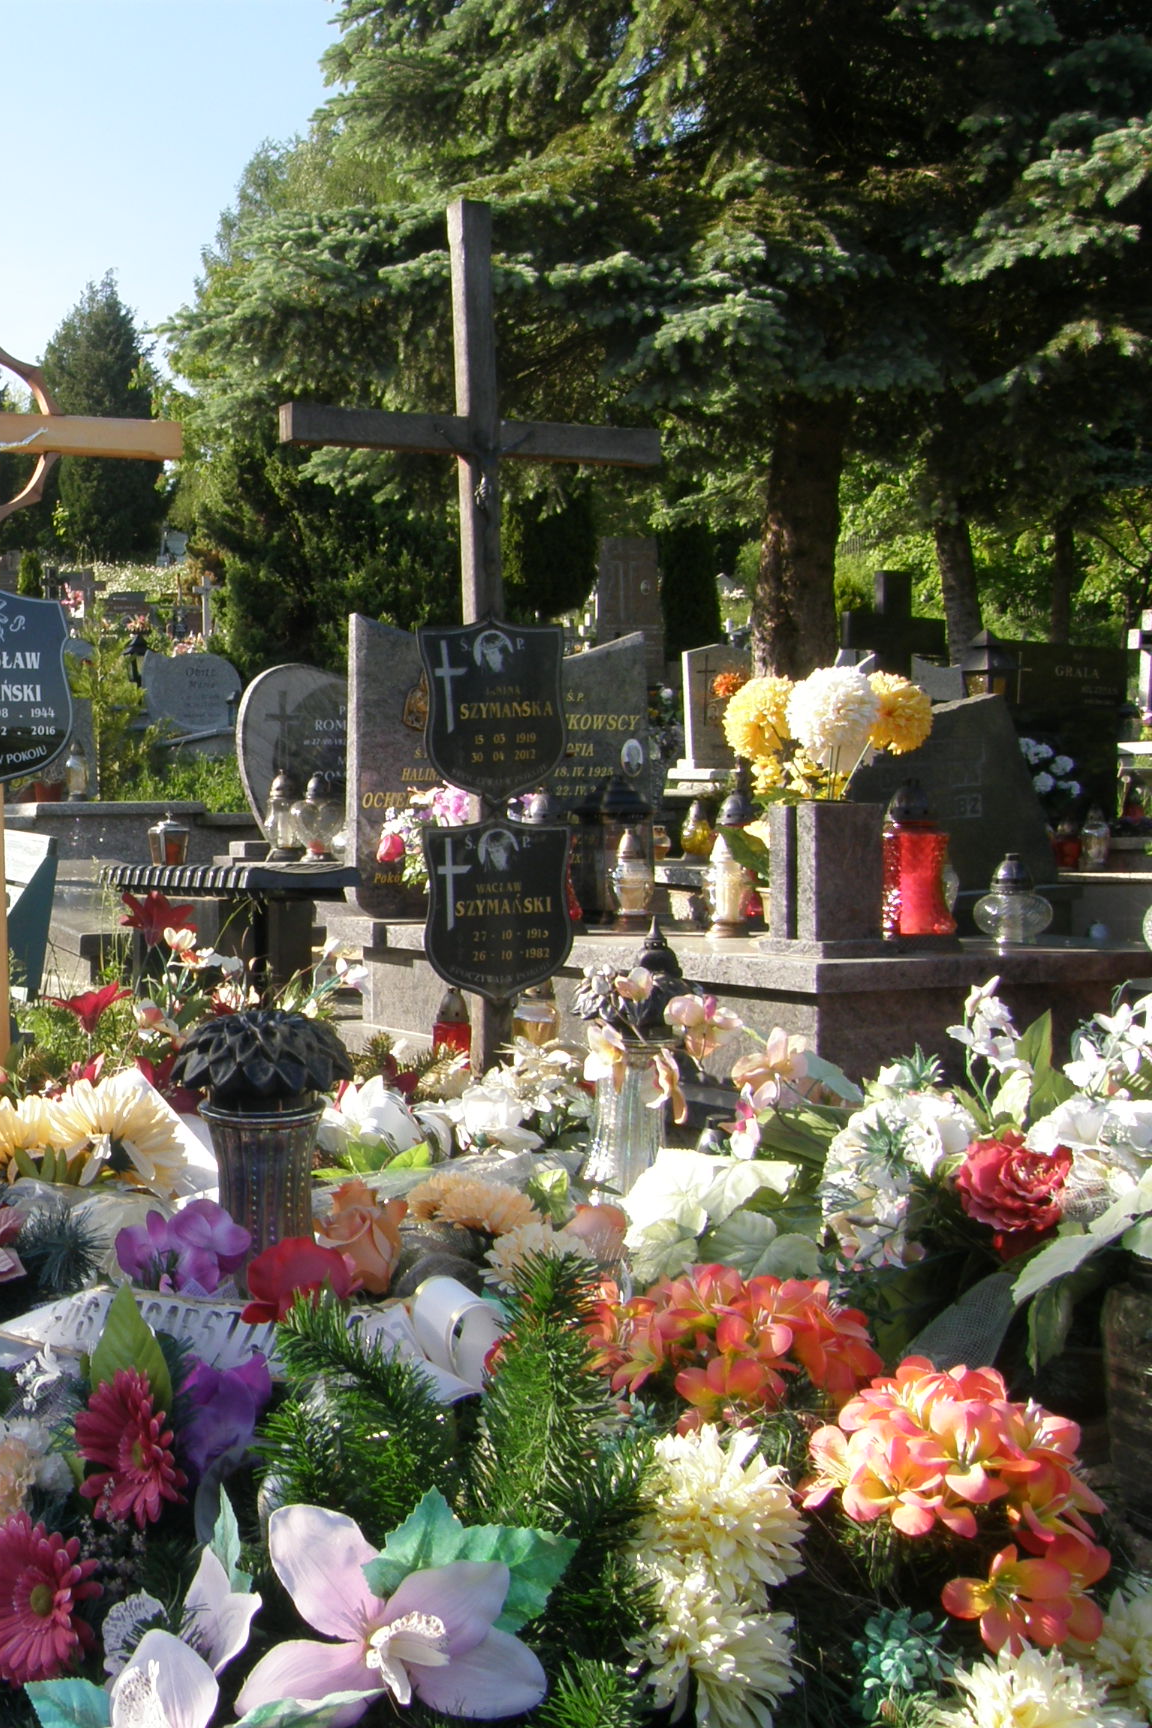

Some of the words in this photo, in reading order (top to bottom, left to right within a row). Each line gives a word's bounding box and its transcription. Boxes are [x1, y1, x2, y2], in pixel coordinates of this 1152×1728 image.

[30, 707, 55, 718] 1944
[460, 698, 553, 720] SZYMAŃSKA
[566, 714, 640, 730] KOWSCY
[31, 725, 55, 736] 2016
[6, 745, 48, 763] POKOJU
[401, 767, 444, 782] HALIN
[476, 881, 522, 894] WACŁAW
[455, 894, 552, 917] SZYMAŃSKI
